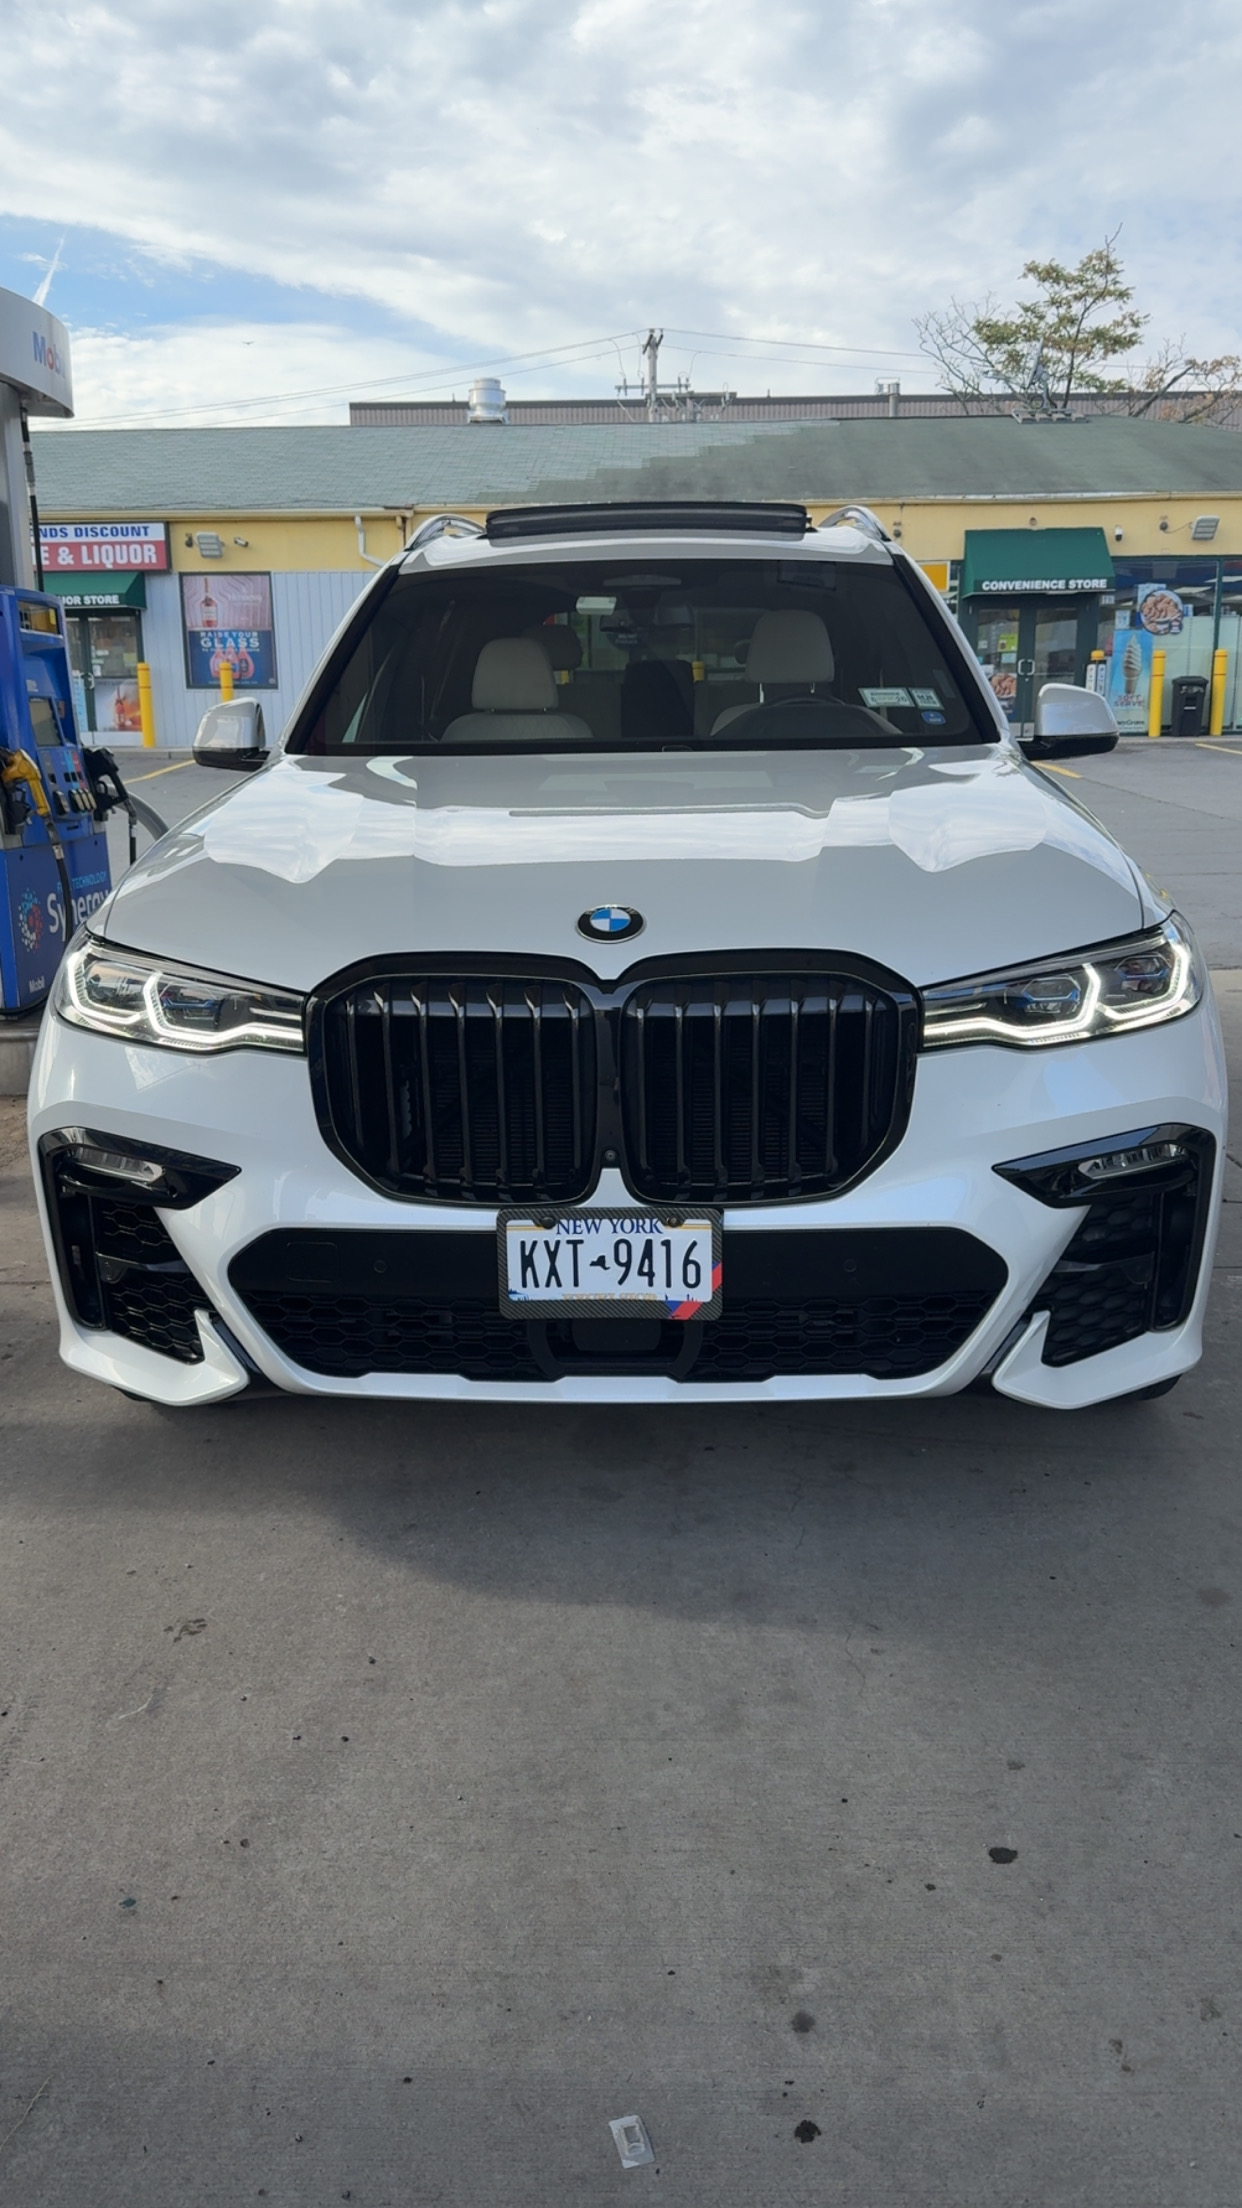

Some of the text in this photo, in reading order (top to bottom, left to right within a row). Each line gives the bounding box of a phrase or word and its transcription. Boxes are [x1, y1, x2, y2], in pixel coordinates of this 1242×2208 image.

[37, 526, 150, 538] NDS DISCOUNT
[57, 546, 74, 565] &
[81, 544, 157, 569] LIQUOR
[982, 579, 1107, 591] CONVENIENCE STORE
[83, 594, 120, 605] STORE
[200, 637, 260, 648] GLASS
[28, 975, 46, 993] Mobil
[555, 1218, 664, 1235] NEW YORK
